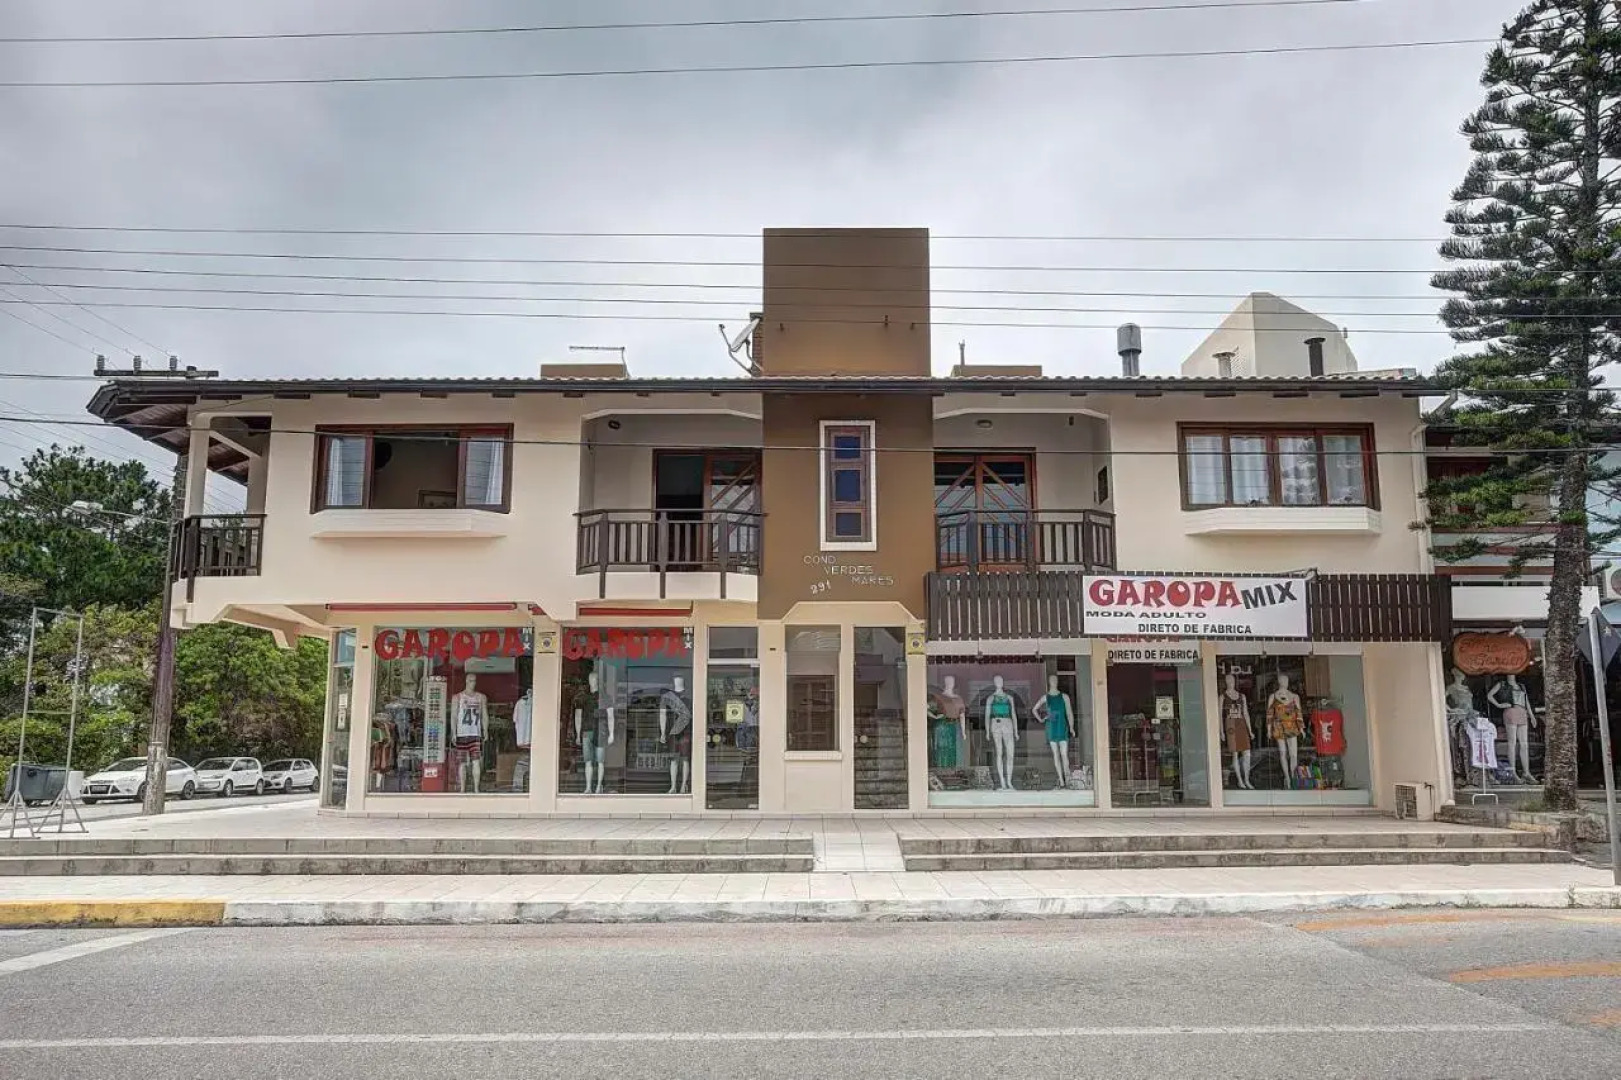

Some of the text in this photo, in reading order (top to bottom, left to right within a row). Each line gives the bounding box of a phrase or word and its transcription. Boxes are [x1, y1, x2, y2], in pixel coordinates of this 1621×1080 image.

[824, 565, 874, 575] VERDES
[810, 579, 832, 594] 291
[851, 576, 894, 586] MARES
[1089, 579, 1298, 610] GAROPA MIX
[1085, 610, 1207, 619] MODA ADULTO
[1138, 623, 1252, 634] DIRETO DE FABRICA
[375, 627, 524, 662] GAROPA
[562, 628, 688, 660] GAROPA
[1108, 650, 1199, 659] DIRETO DE FABRICA
